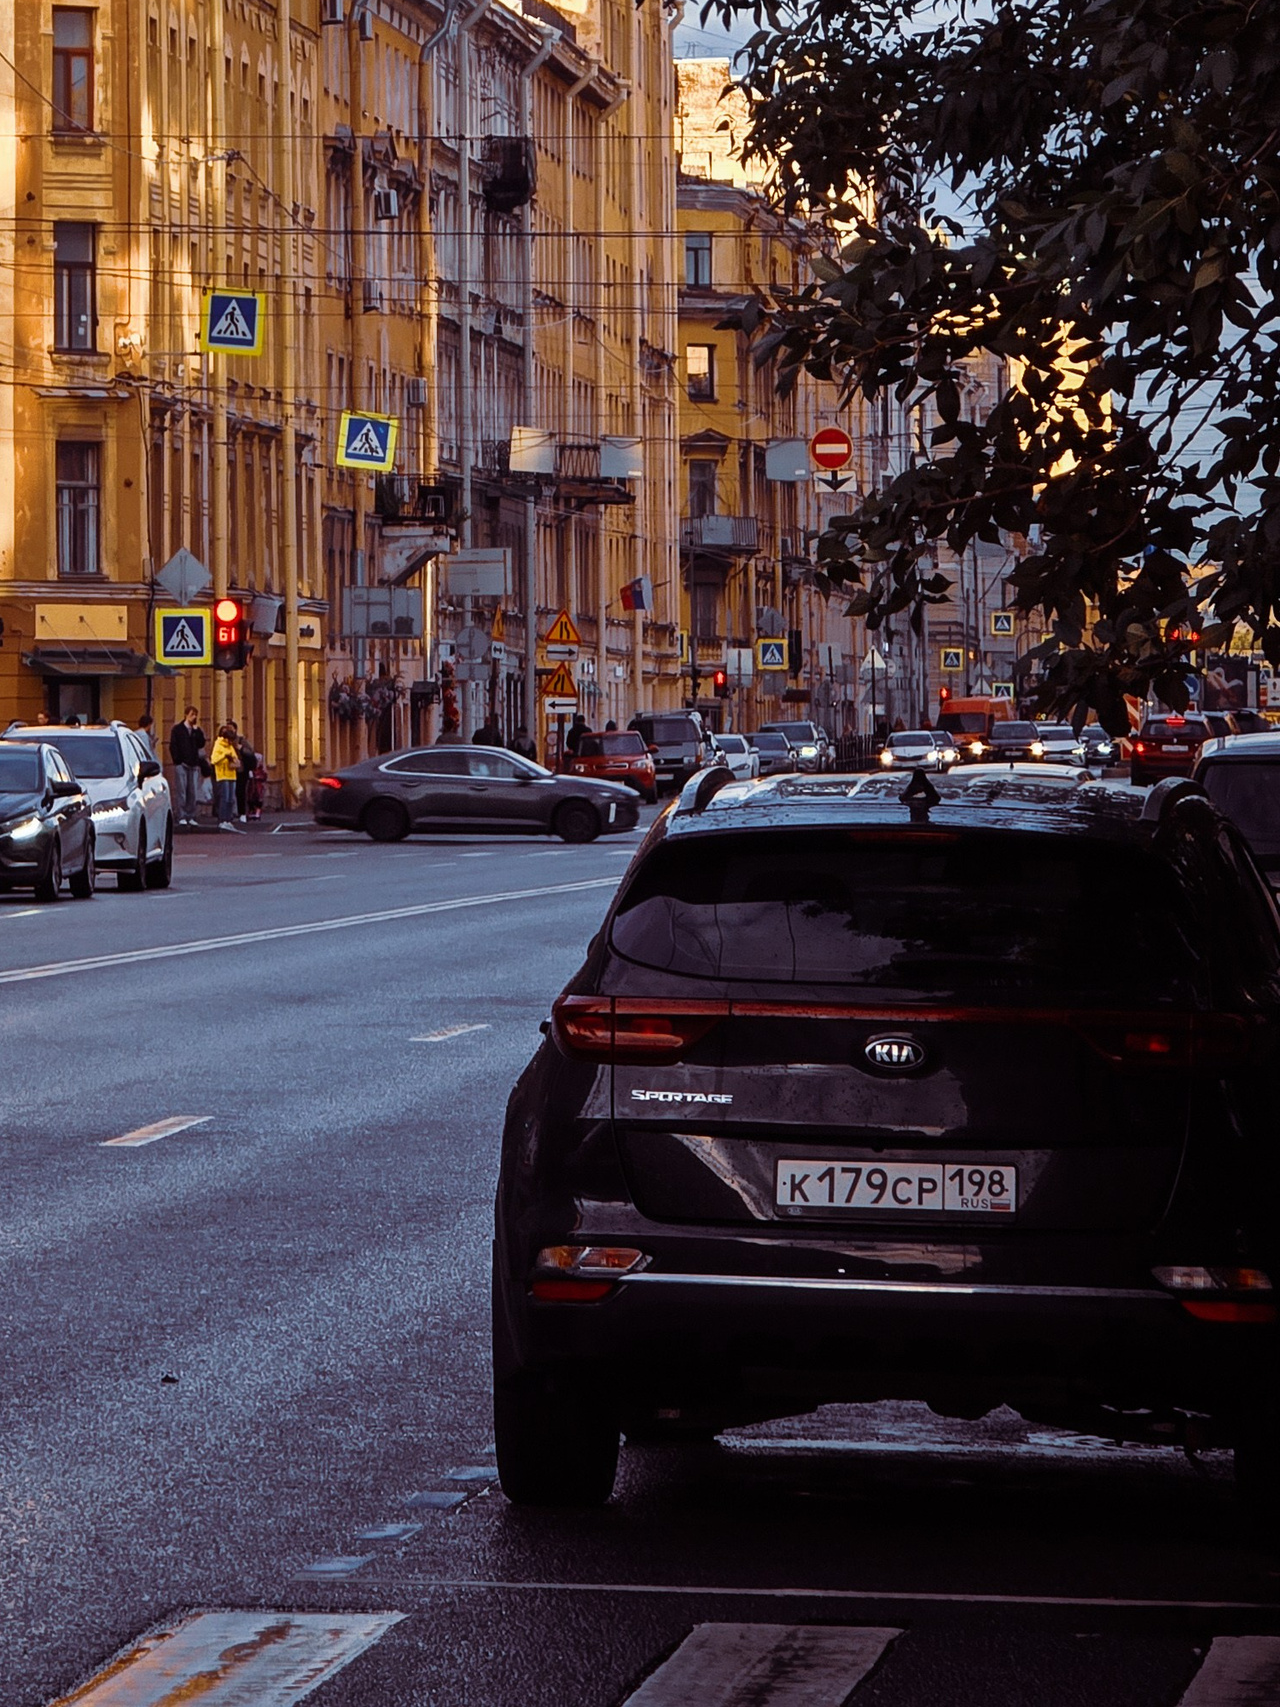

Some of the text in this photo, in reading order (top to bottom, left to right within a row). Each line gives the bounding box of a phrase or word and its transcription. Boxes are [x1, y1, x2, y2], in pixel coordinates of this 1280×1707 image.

[219, 627, 236, 642] 61
[875, 1044, 916, 1062] KIA
[631, 1089, 734, 1105] SPORTAGE
[961, 1197, 989, 1209] RUS
